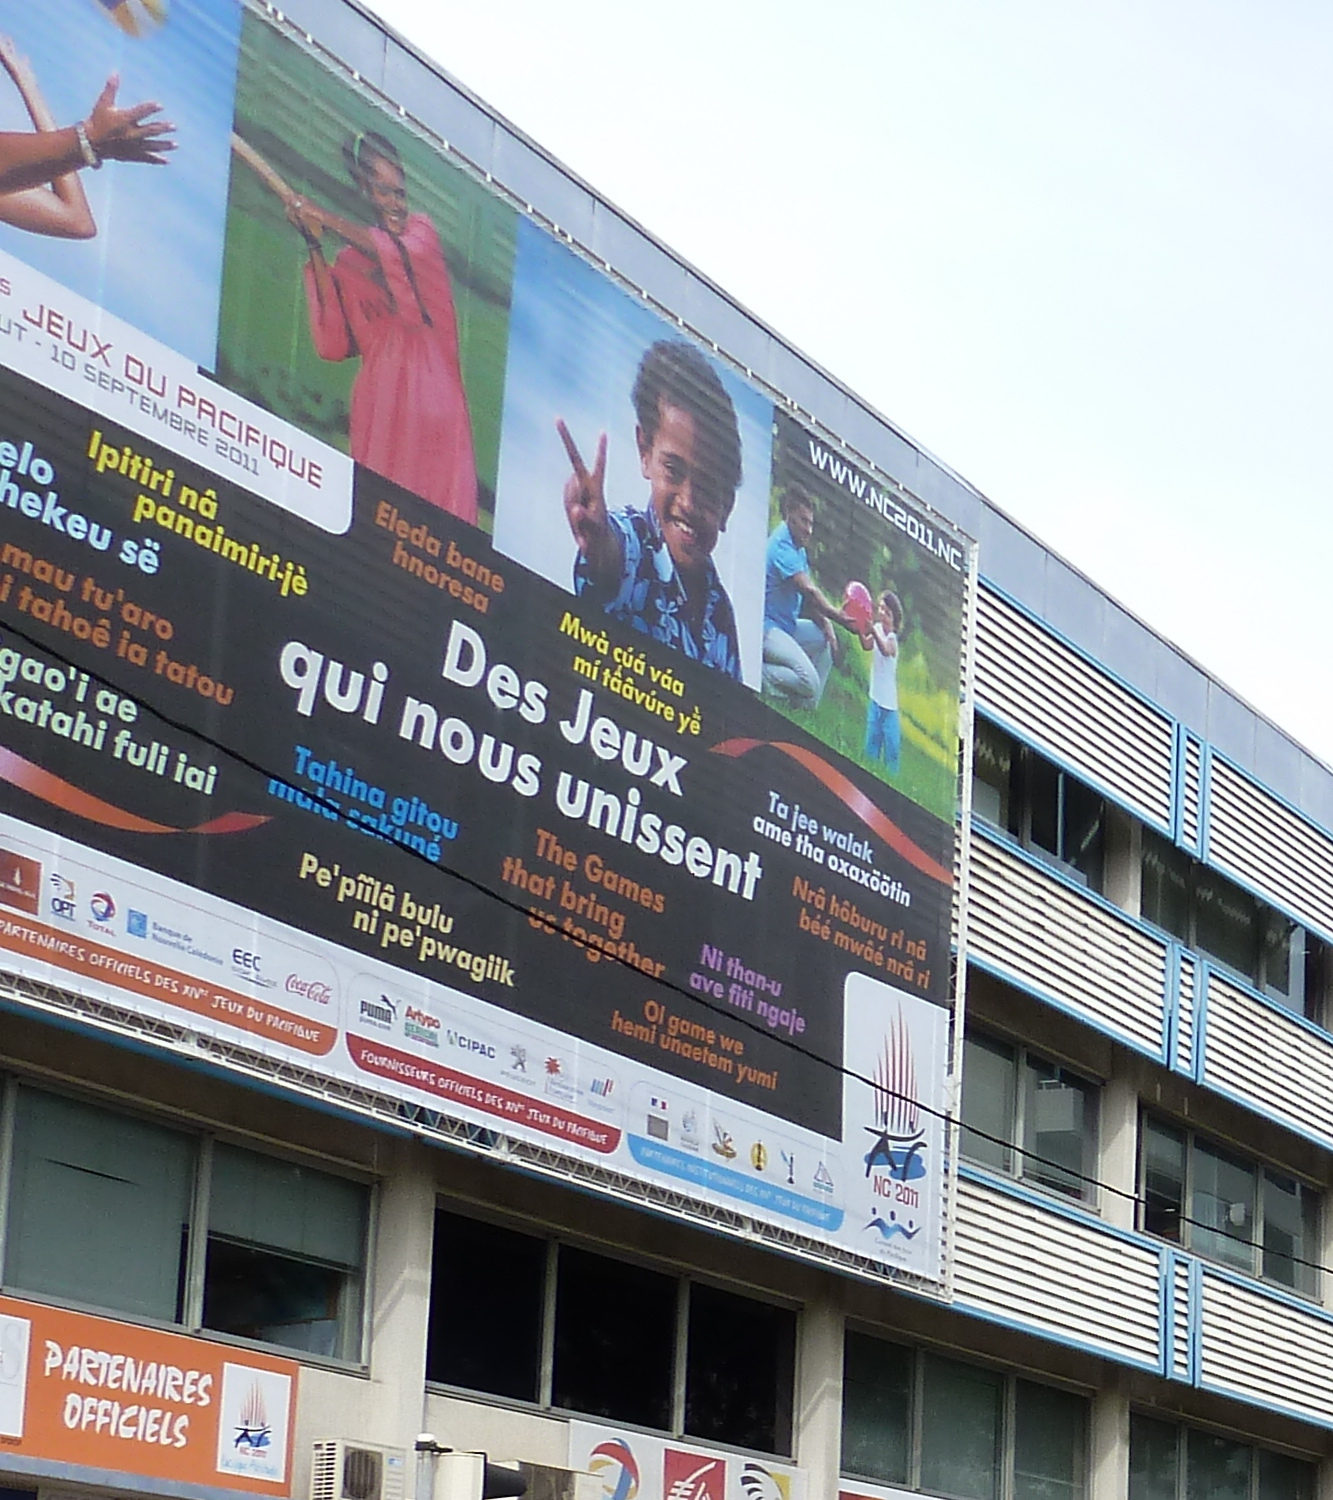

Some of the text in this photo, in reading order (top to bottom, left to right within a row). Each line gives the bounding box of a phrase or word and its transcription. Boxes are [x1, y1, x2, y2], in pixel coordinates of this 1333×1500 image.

[22, 304, 113, 368] JEUX
[124, 353, 167, 398] DU
[177, 384, 323, 489] PACIFIQUE
[51, 344, 76, 371] 10
[83, 365, 209, 447] SEPTEMBRE
[215, 437, 260, 476] 2011
[87, 429, 219, 520] Ipitiri nâ
[808, 439, 963, 573] WWW.NC2011.NC
[118, 537, 161, 575] së
[133, 493, 309, 597] panaimiri-jè
[375, 500, 506, 593] Eleda bane
[392, 539, 489, 614] hnoresa
[17, 585, 111, 650] tahoê
[116, 630, 149, 667] ia
[154, 650, 235, 706] tatou
[81, 576, 174, 640] tu'aro
[559, 611, 611, 656] Mwà
[95, 689, 139, 723] ae
[441, 618, 690, 797] Des Jeux
[112, 729, 170, 776] fuli
[173, 752, 219, 796] iai
[278, 640, 764, 902] qui nous unissent
[293, 745, 460, 841] Tahina gitou
[752, 816, 913, 908] ame tha oxaxöötin
[768, 789, 875, 866] Ta jee walak
[51, 897, 77, 918] OPT
[501, 856, 626, 941] that bring
[535, 827, 667, 914] The Games
[86, 919, 117, 938] TOTAL
[351, 909, 516, 988] ni pe'pwagiik
[399, 891, 455, 935] bulu
[527, 905, 667, 980] us together
[792, 875, 827, 911] Nrâ
[828, 893, 889, 942] hôburu
[905, 939, 927, 961] nâ
[798, 906, 832, 941] béé
[886, 956, 915, 982] nrâ
[88, 952, 152, 984] OFFICIELS
[153, 973, 179, 994] DES
[210, 994, 245, 1016] JEUX
[246, 1007, 264, 1023] DU
[264, 1013, 322, 1044] PACIFIQUE
[232, 948, 262, 973] EEC
[700, 942, 784, 998] Ni than-u
[643, 999, 745, 1056] Ol game we
[689, 969, 807, 1036] ave fiti ngaje
[457, 1031, 497, 1059] CIPAC
[610, 1010, 779, 1091] hemi unaetem yumi
[360, 1049, 437, 1086] FOURNISSEURS
[437, 1075, 484, 1103] OFFICIELS
[483, 1091, 504, 1110] DES
[551, 1116, 567, 1131] DU
[873, 1174, 920, 1210] NC 2011
[43, 1338, 213, 1408] PARTENAIRES
[62, 1391, 190, 1449] OFFICIELS
